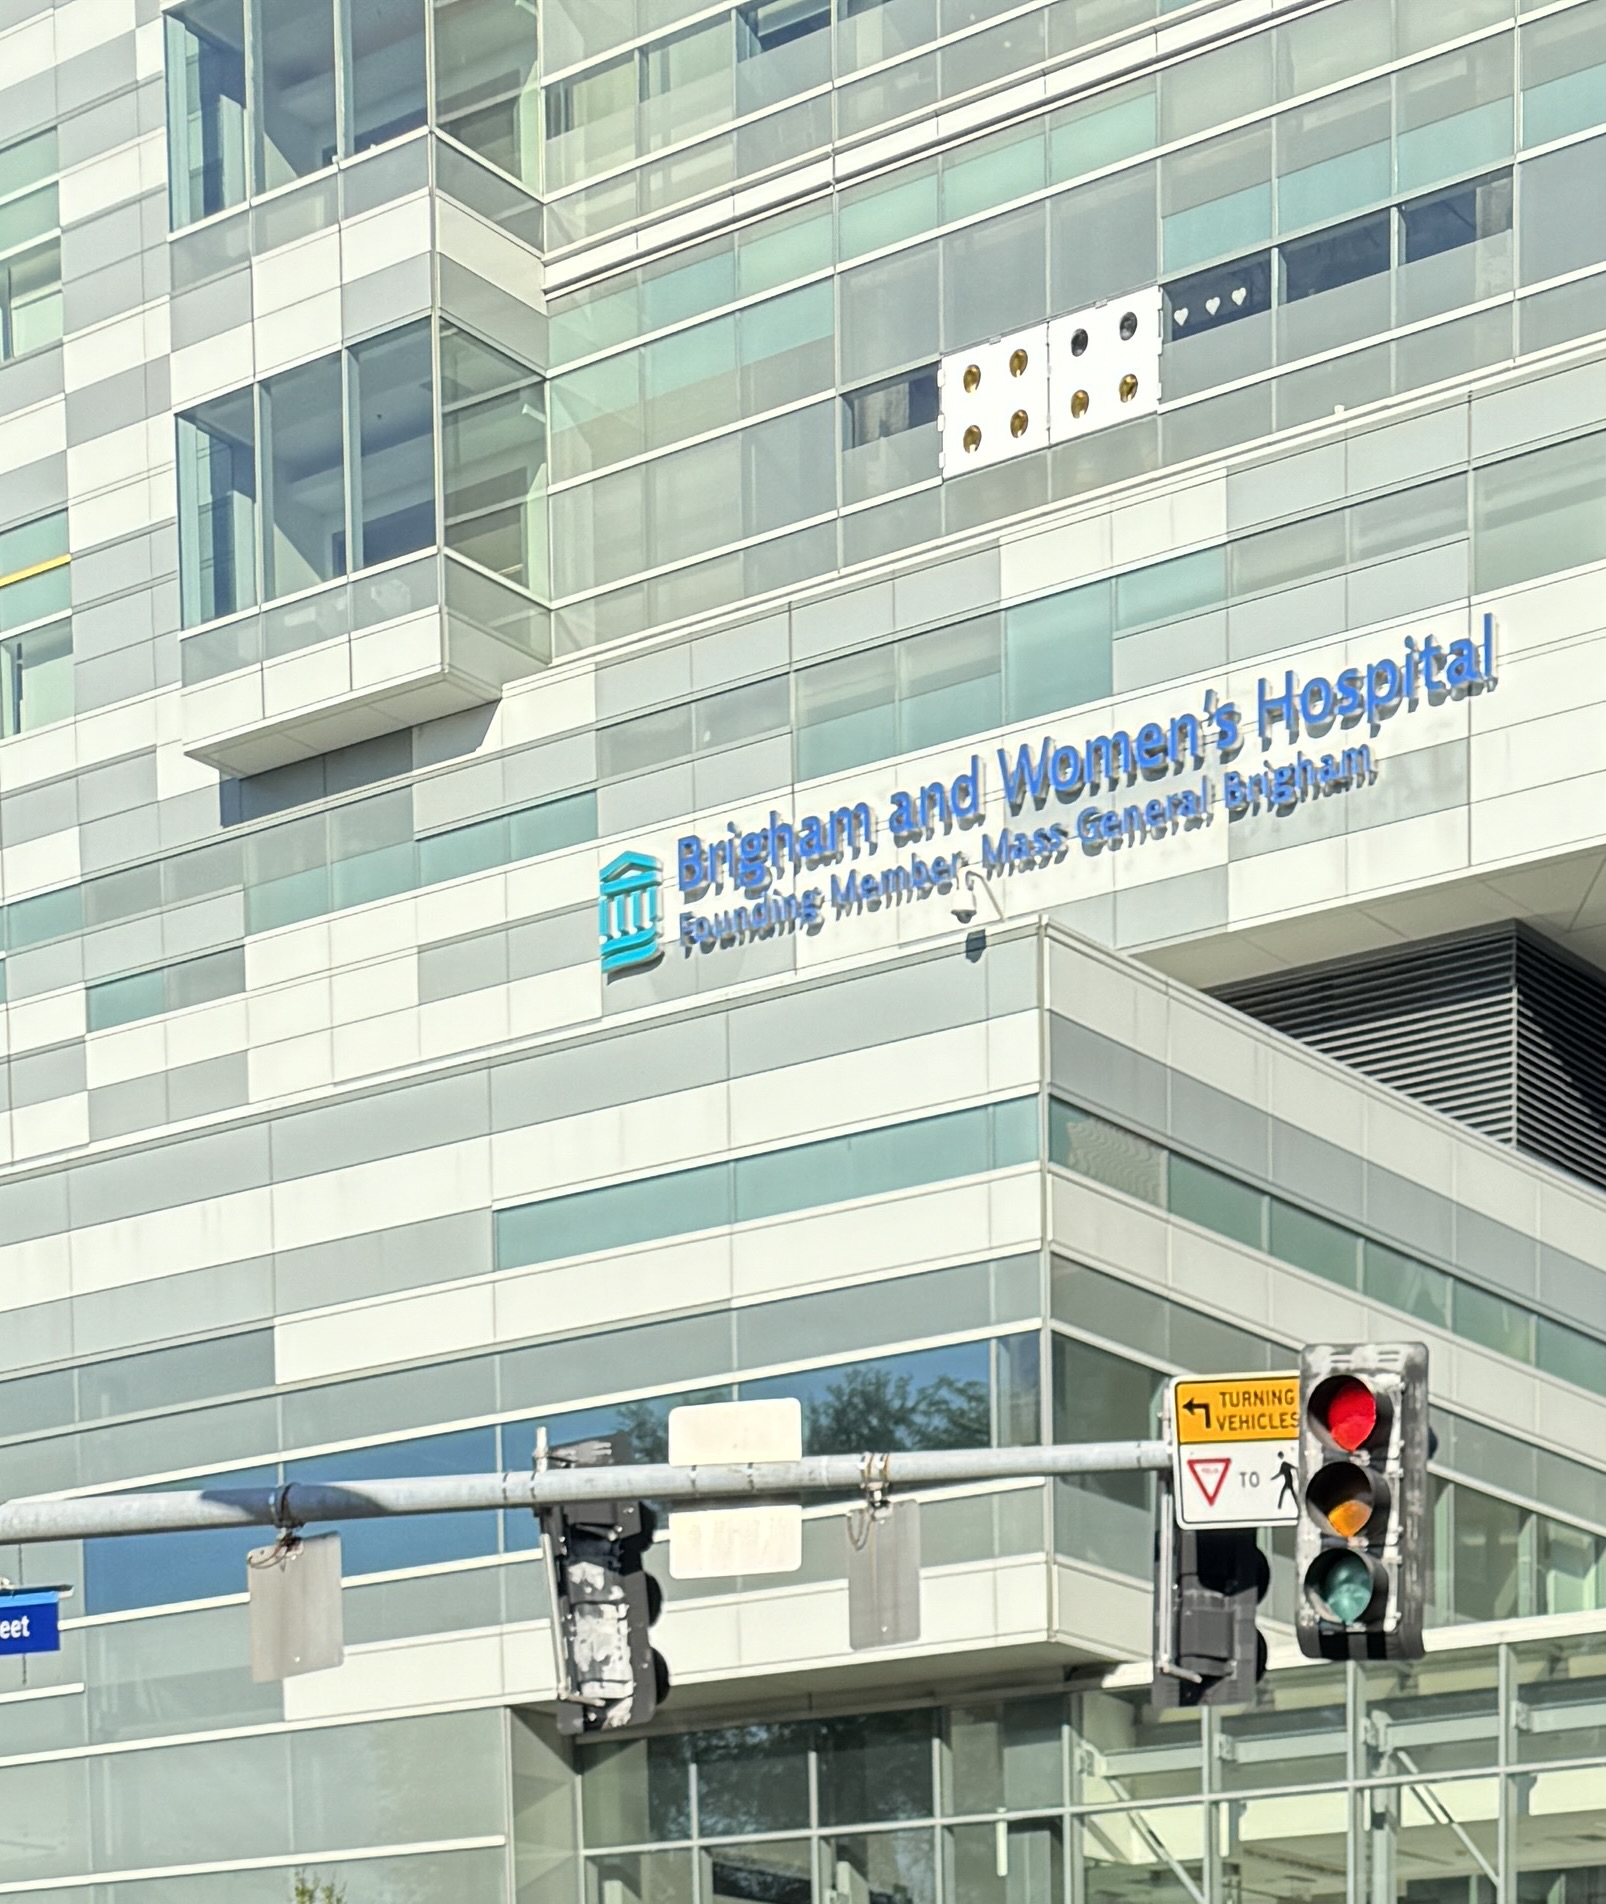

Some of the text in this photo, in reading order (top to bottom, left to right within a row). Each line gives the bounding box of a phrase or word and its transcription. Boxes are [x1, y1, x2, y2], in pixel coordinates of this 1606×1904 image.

[678, 612, 1493, 892] Brigham and Women's Hospital
[679, 887, 825, 947] Founding
[982, 823, 1068, 868] Mass
[1077, 775, 1210, 845] General
[1224, 744, 1374, 808] Brigham
[1219, 1388, 1295, 1408] TURNING
[1216, 1411, 1300, 1431] VEHICLES
[1239, 1471, 1260, 1488] TO
